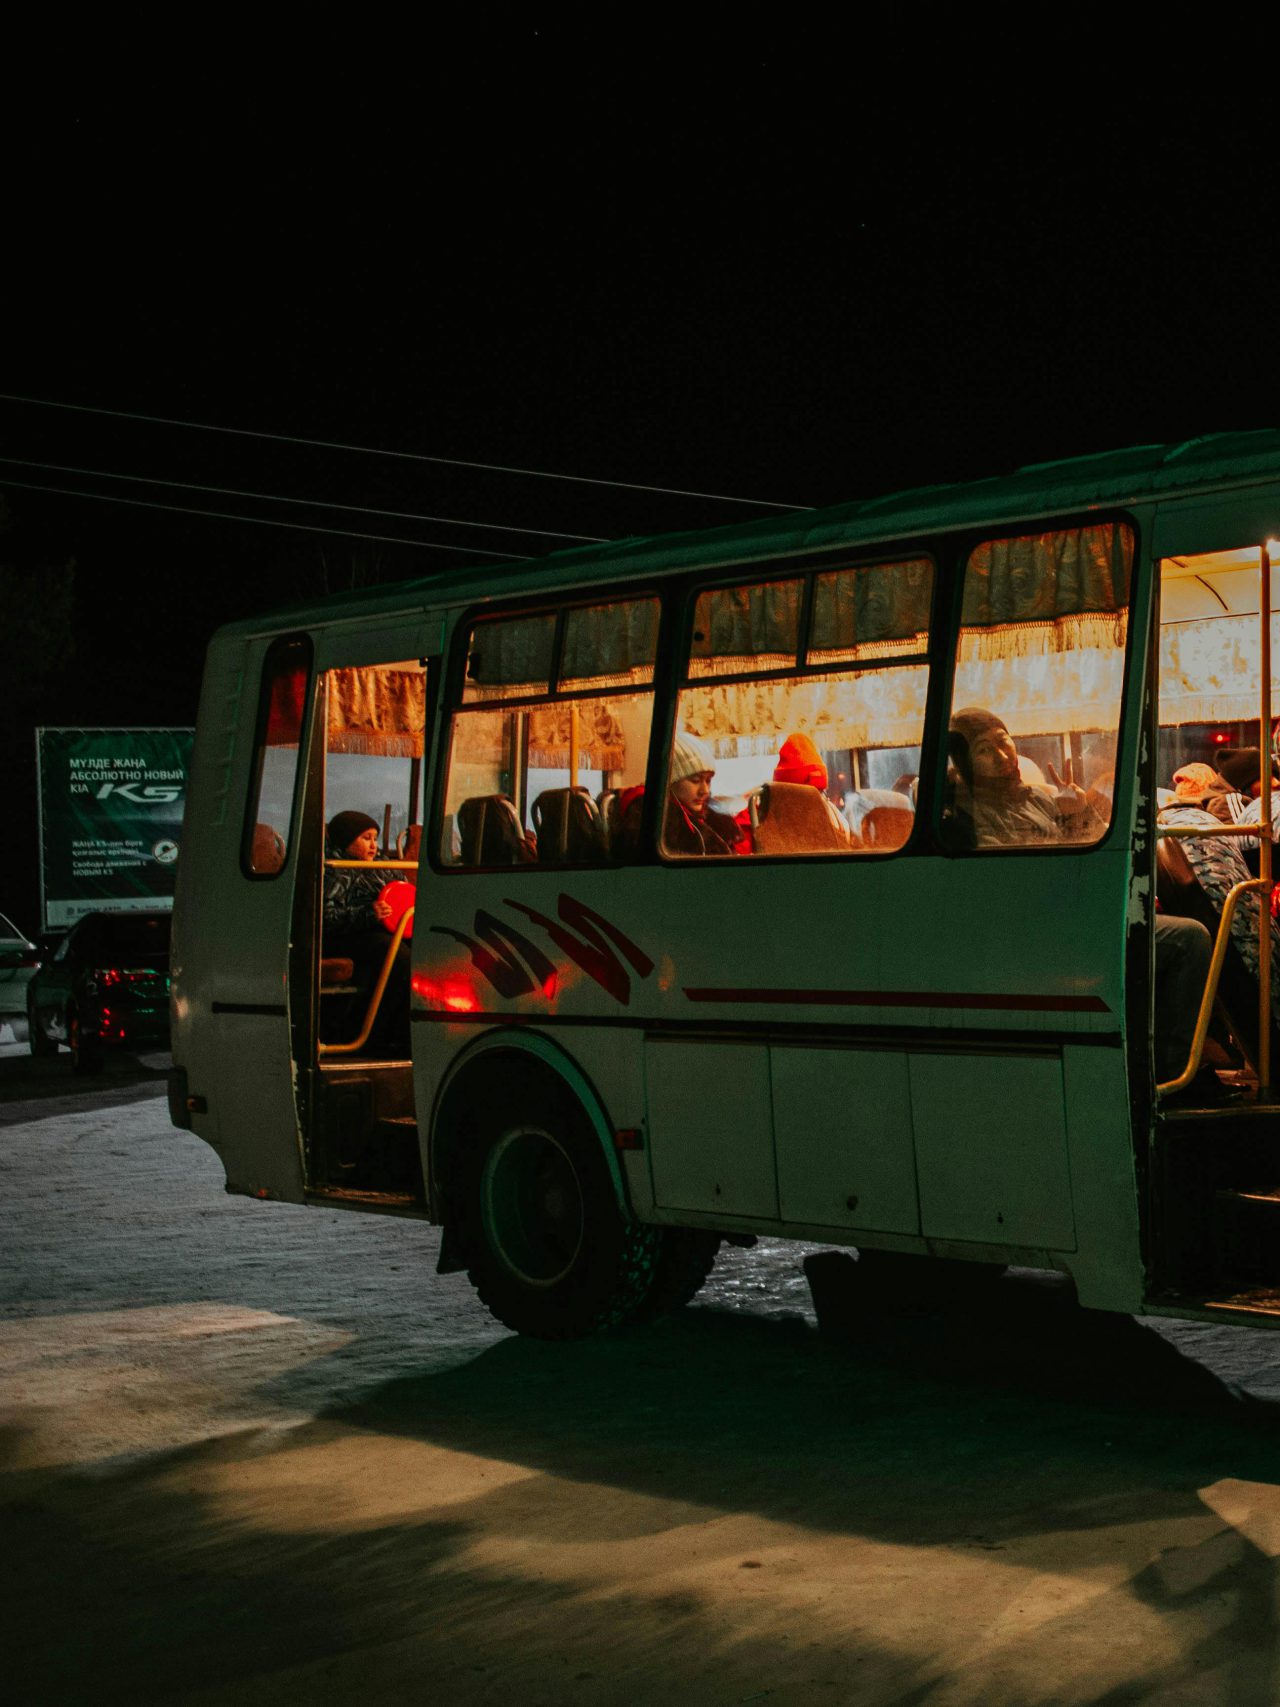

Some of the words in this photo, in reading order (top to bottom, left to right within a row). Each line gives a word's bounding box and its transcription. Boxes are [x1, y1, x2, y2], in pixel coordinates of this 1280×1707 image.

[113, 758, 147, 769] ЖАҢА
[70, 771, 141, 781] АБСОЛЮТНО
[144, 768, 184, 780] НОВЫЙ
[70, 783, 89, 794] KIA
